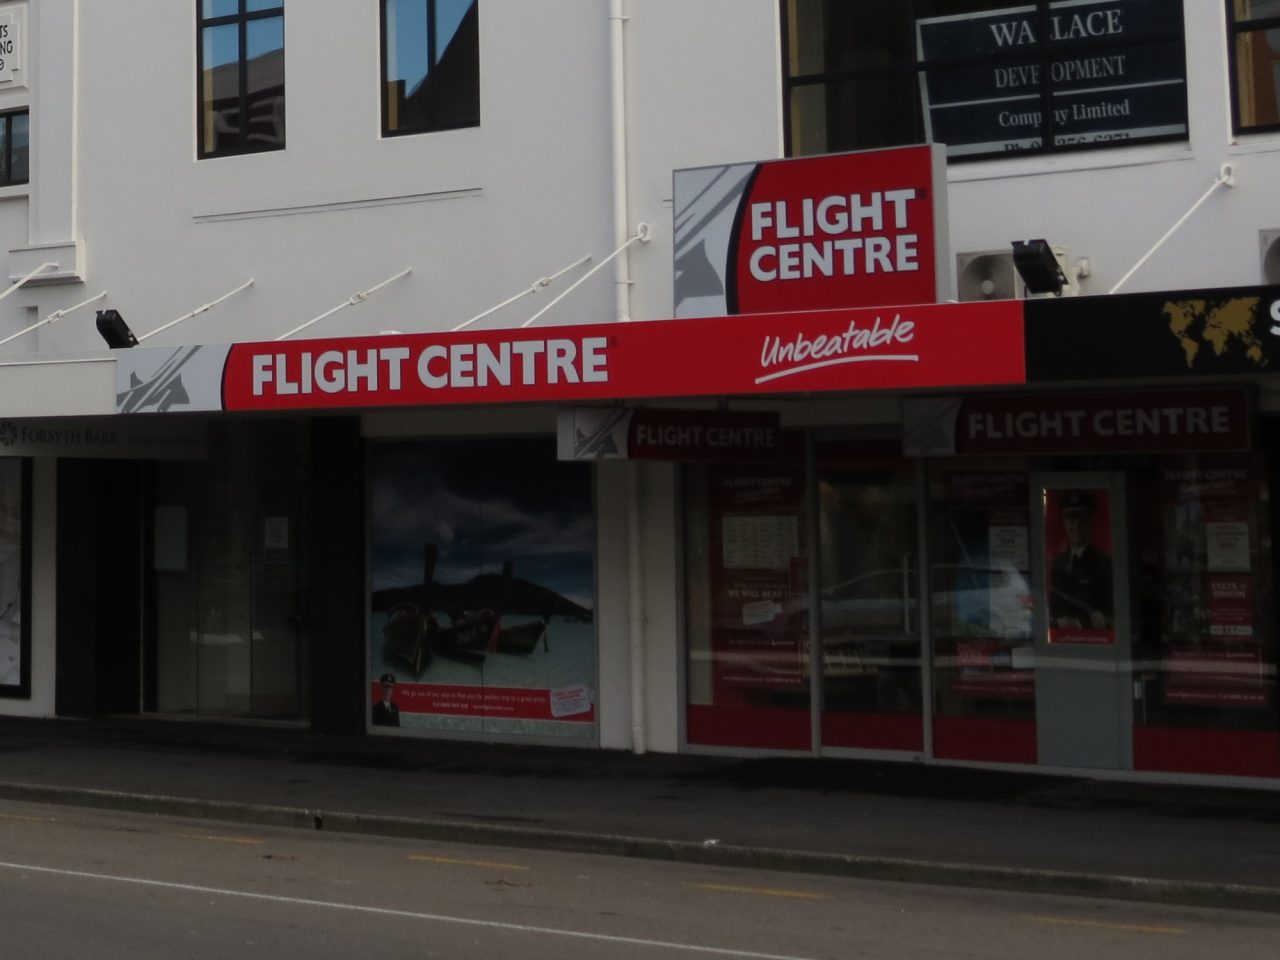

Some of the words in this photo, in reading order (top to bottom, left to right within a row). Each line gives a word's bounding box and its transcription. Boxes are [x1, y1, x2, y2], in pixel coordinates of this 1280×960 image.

[990, 9, 1124, 48] WALACE
[994, 55, 1126, 88] DEVEOPMENT
[1072, 99, 1131, 122] Limited
[751, 188, 918, 241] FLIGHT
[749, 234, 919, 282] CENTRE
[760, 314, 916, 368] Unbeatable
[252, 346, 410, 396] FLIGHT
[417, 337, 608, 389] CENTRE
[22, 426, 81, 446] FORSYTH
[637, 424, 702, 446] FLIGHT
[705, 426, 775, 448] CENTRE
[968, 409, 1085, 440] FLIGHT
[1093, 405, 1231, 437] CENTRE
